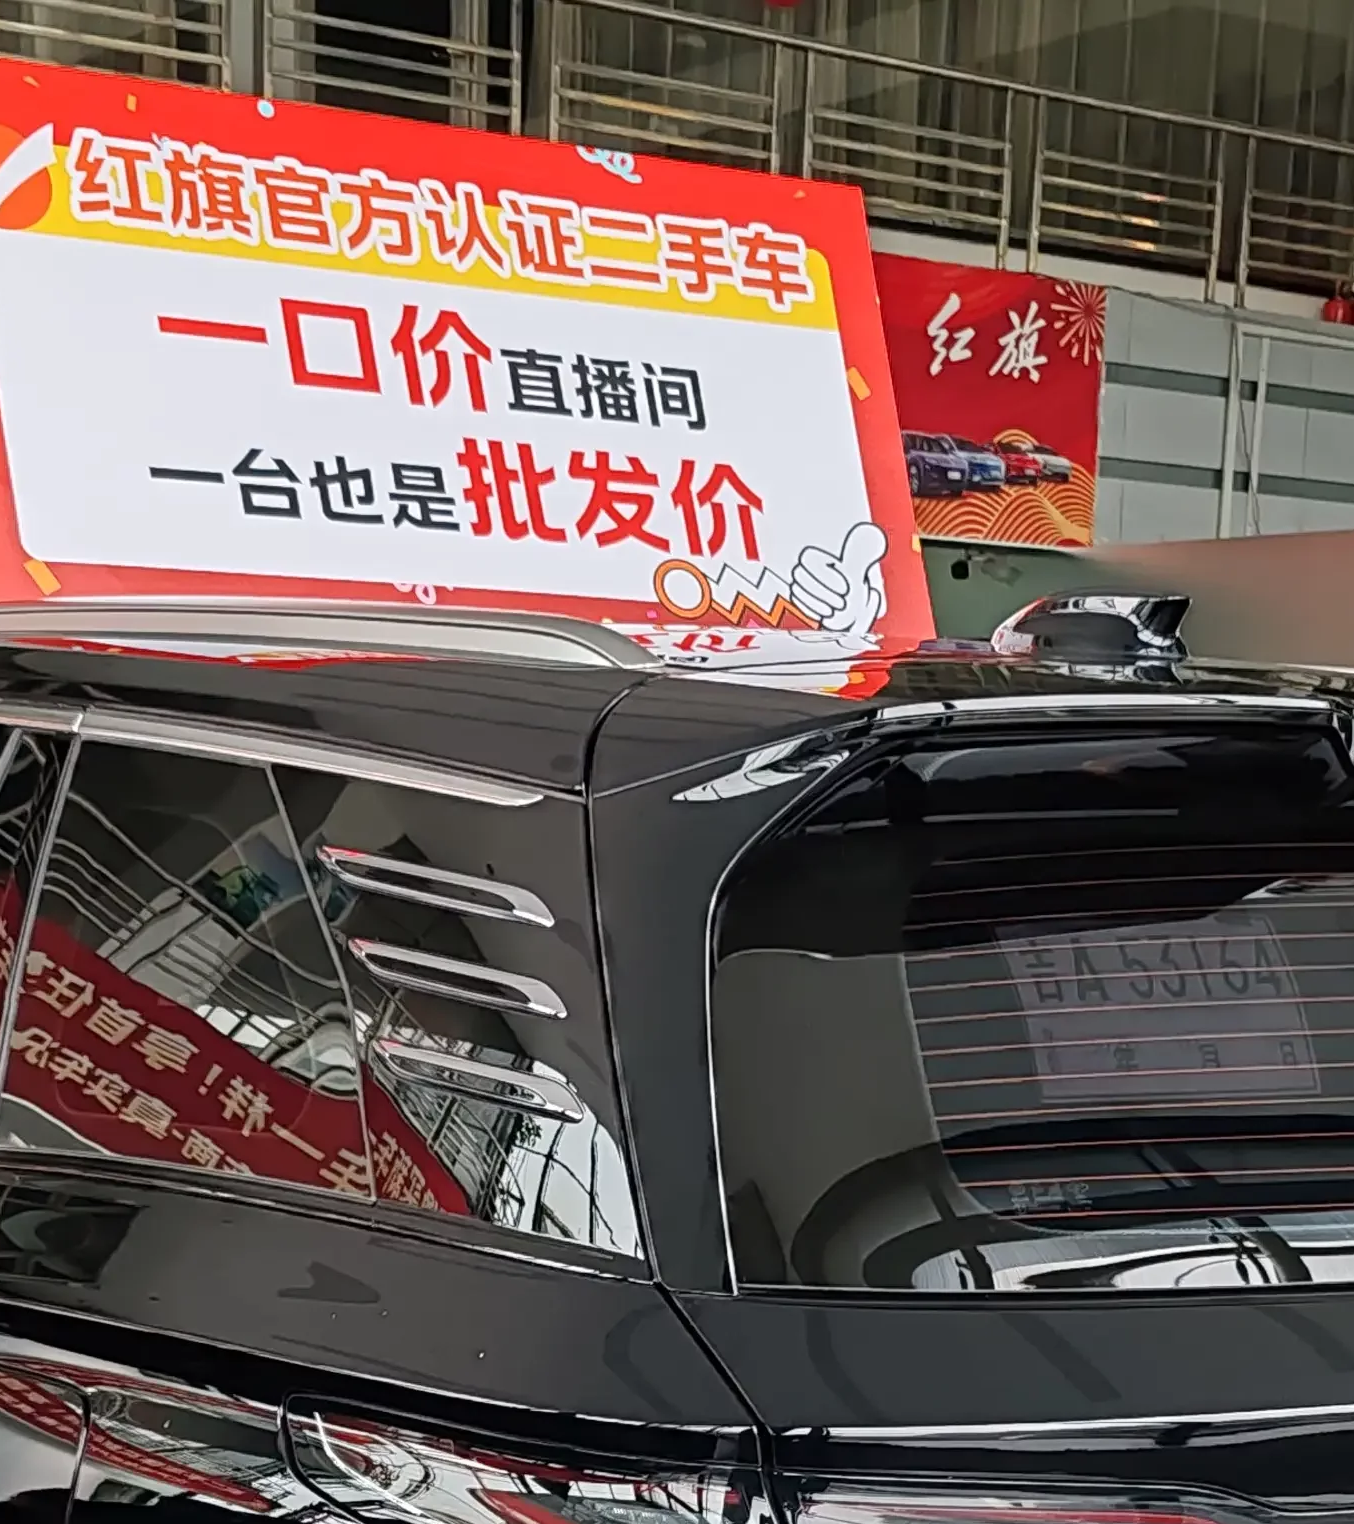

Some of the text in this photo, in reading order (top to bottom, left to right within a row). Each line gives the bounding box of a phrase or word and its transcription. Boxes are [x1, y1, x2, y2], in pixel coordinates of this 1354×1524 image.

[71, 133, 813, 308] 红旗官方认证二手车
[157, 298, 707, 431] 一口价直播间
[926, 292, 1048, 384] 红旗
[149, 437, 763, 561] 一台也是批发价
